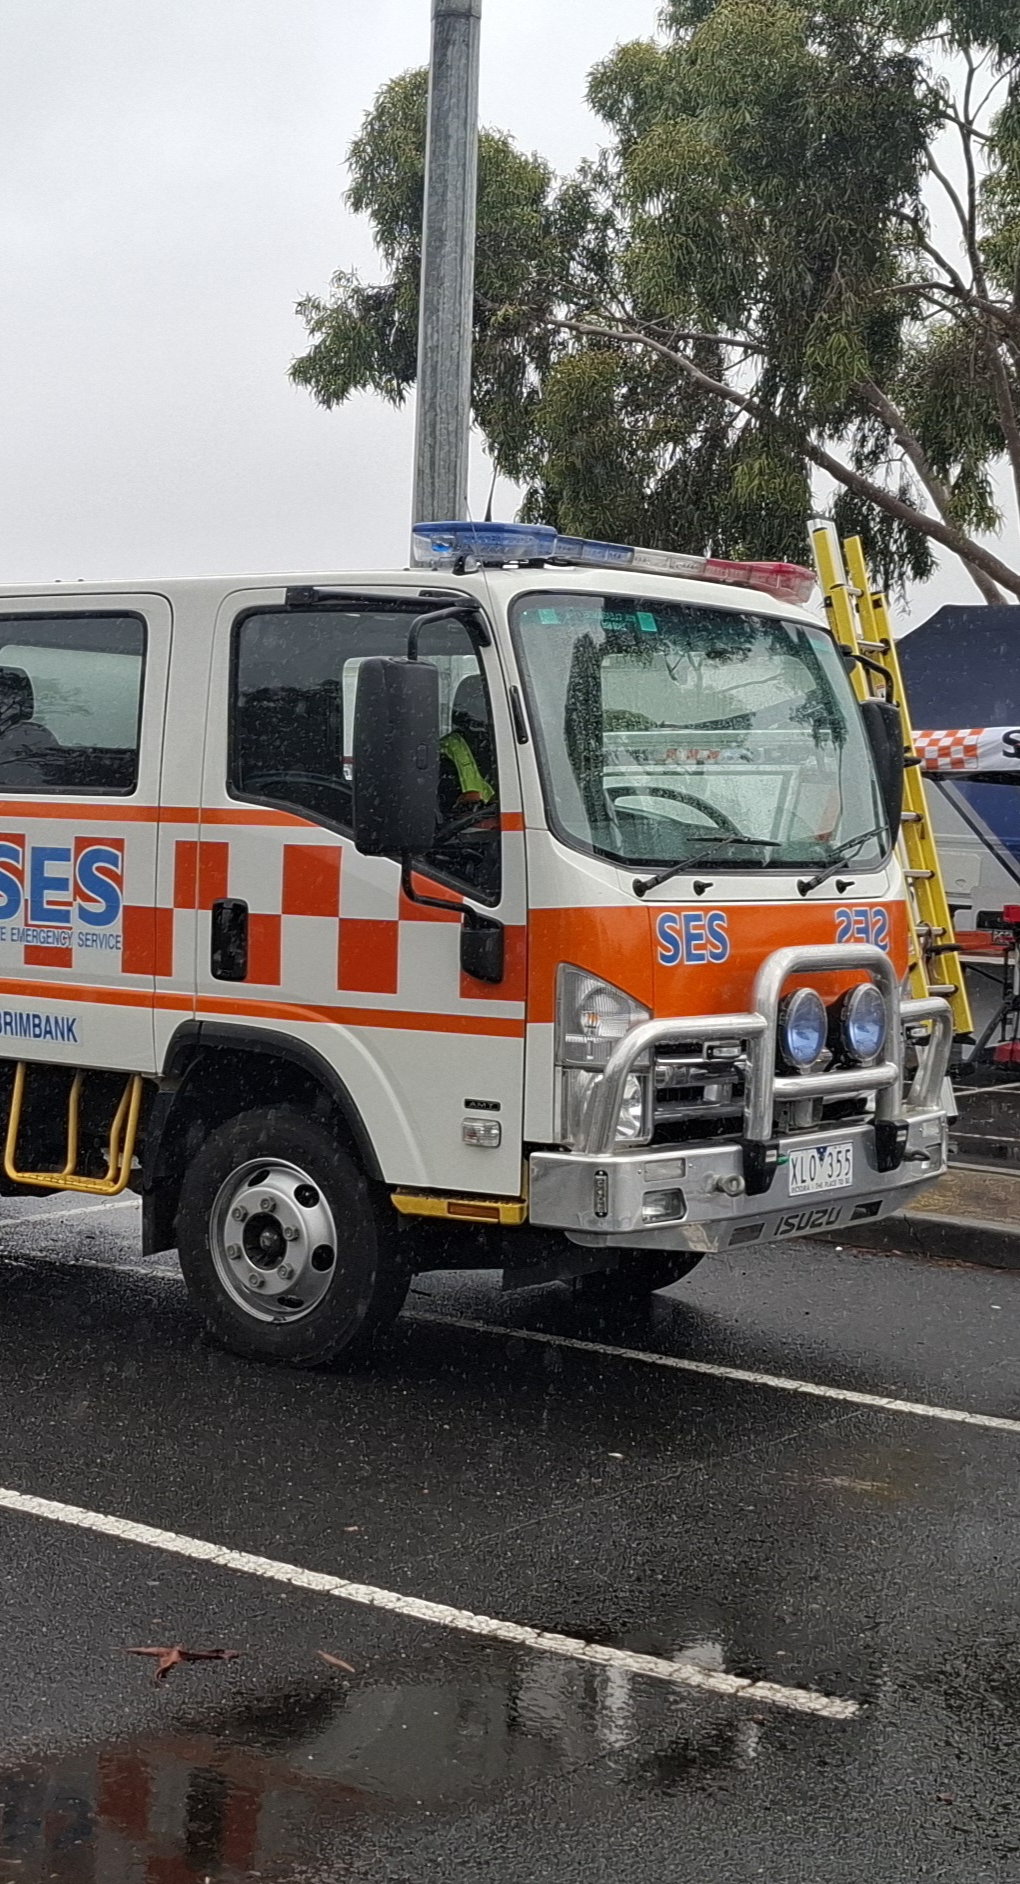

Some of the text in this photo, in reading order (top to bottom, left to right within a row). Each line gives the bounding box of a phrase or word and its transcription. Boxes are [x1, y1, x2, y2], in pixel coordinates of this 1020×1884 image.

[10, 926, 74, 948] EMERGENCY
[77, 931, 123, 951] SERVICE
[656, 910, 730, 967] SES
[827, 1148, 851, 1179] 355
[773, 1206, 843, 1236] ISUZU
